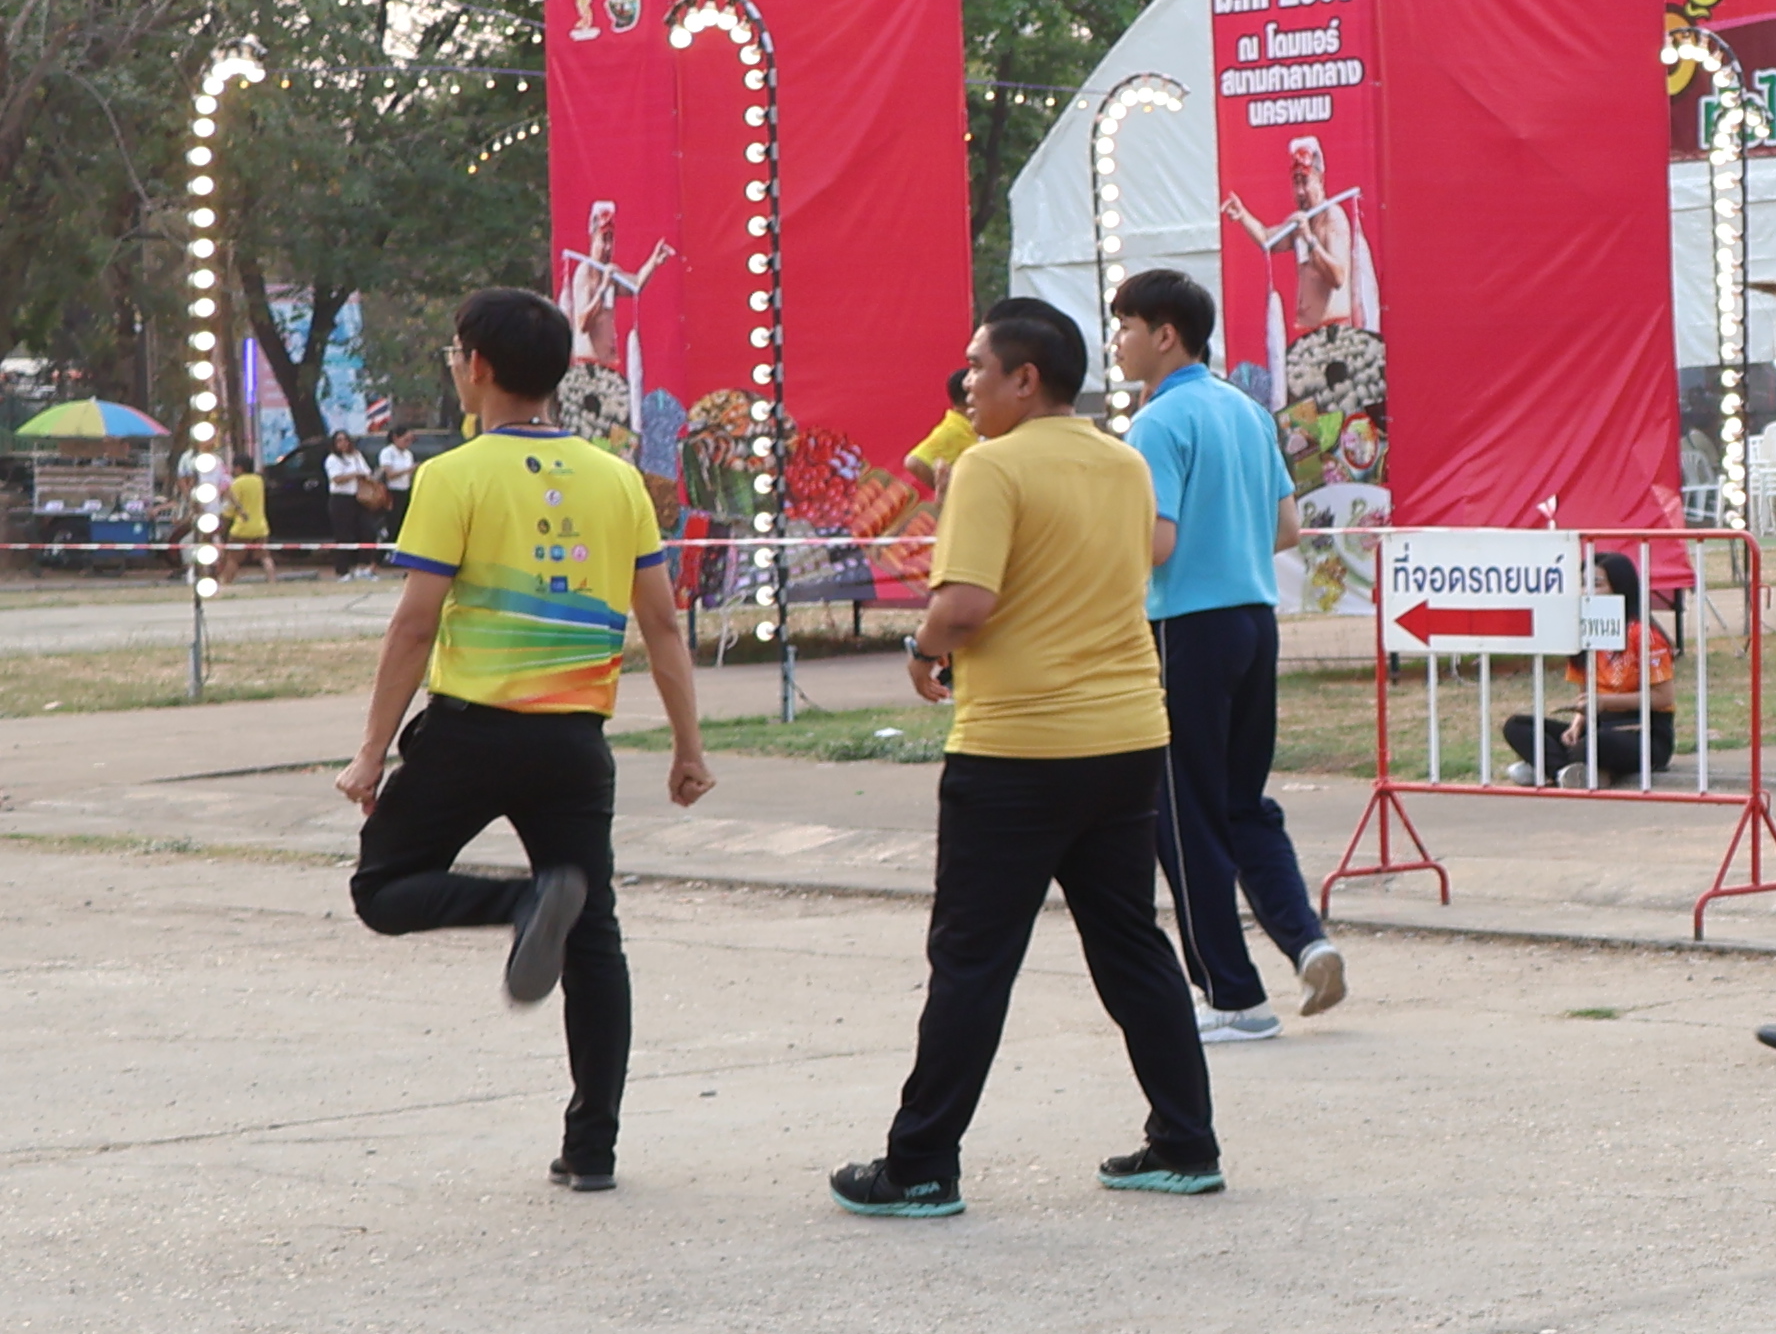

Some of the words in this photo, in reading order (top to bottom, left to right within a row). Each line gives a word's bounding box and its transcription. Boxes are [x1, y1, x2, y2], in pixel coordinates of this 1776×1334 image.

[1237, 34, 1260, 63] ณ
[1264, 19, 1341, 60] โดมแอร์
[1220, 57, 1364, 97] สนามศาลากลาง
[1248, 93, 1333, 128] นครพนม
[1392, 540, 1566, 596] ที่จอดรถยนต์
